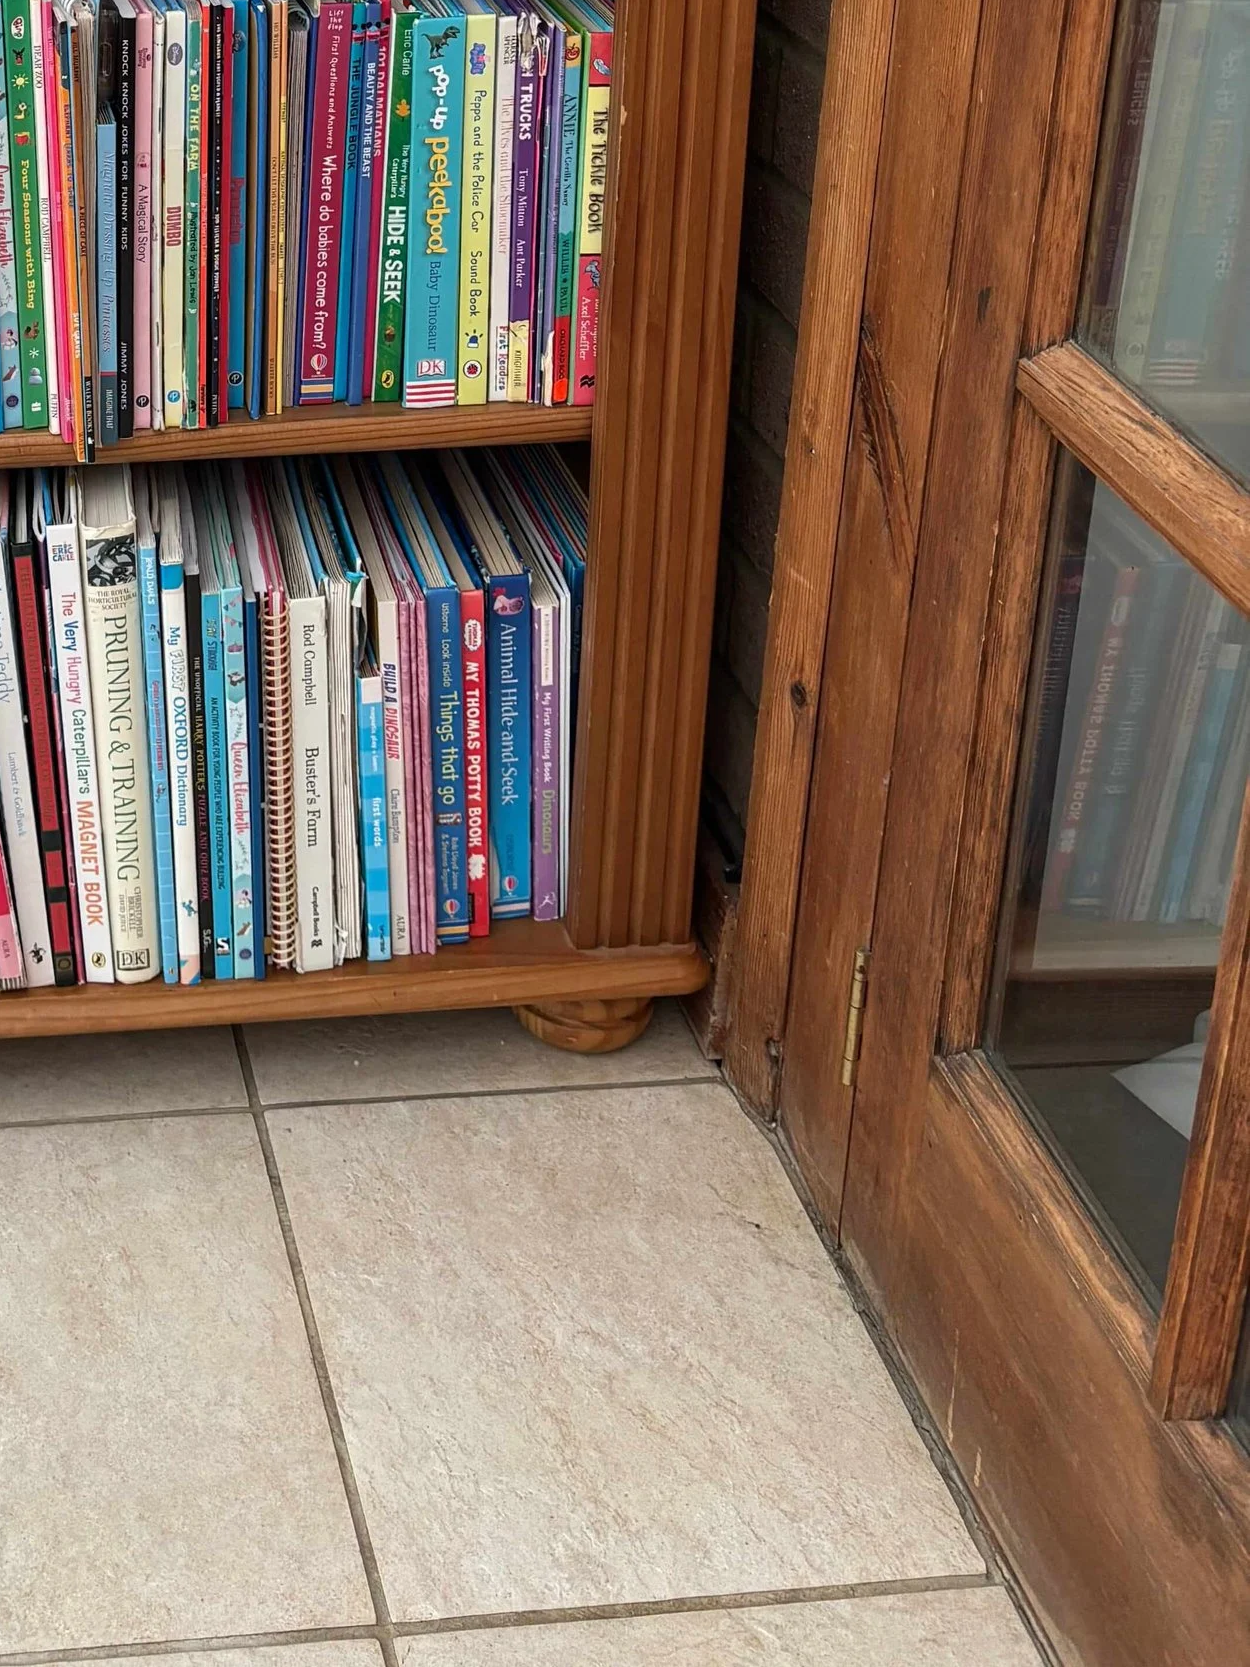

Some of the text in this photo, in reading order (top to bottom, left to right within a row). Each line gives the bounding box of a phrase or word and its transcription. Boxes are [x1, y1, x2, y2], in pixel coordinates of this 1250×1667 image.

[120, 38, 129, 251] KNOCK KNOCK JOKES FOR FUNNY KIDS
[166, 205, 182, 248] DUMBO
[311, 155, 334, 349] Where do babies come from?
[383, 206, 407, 304] HIDE & SEEK
[430, 261, 442, 291] Baby
[426, 293, 443, 352] Dinosaur
[103, 615, 141, 883] PRUNING & TRAINING
[465, 661, 482, 847] MY THOMAS POTTY BOOK
[76, 800, 105, 927] MAGNET BOOK
